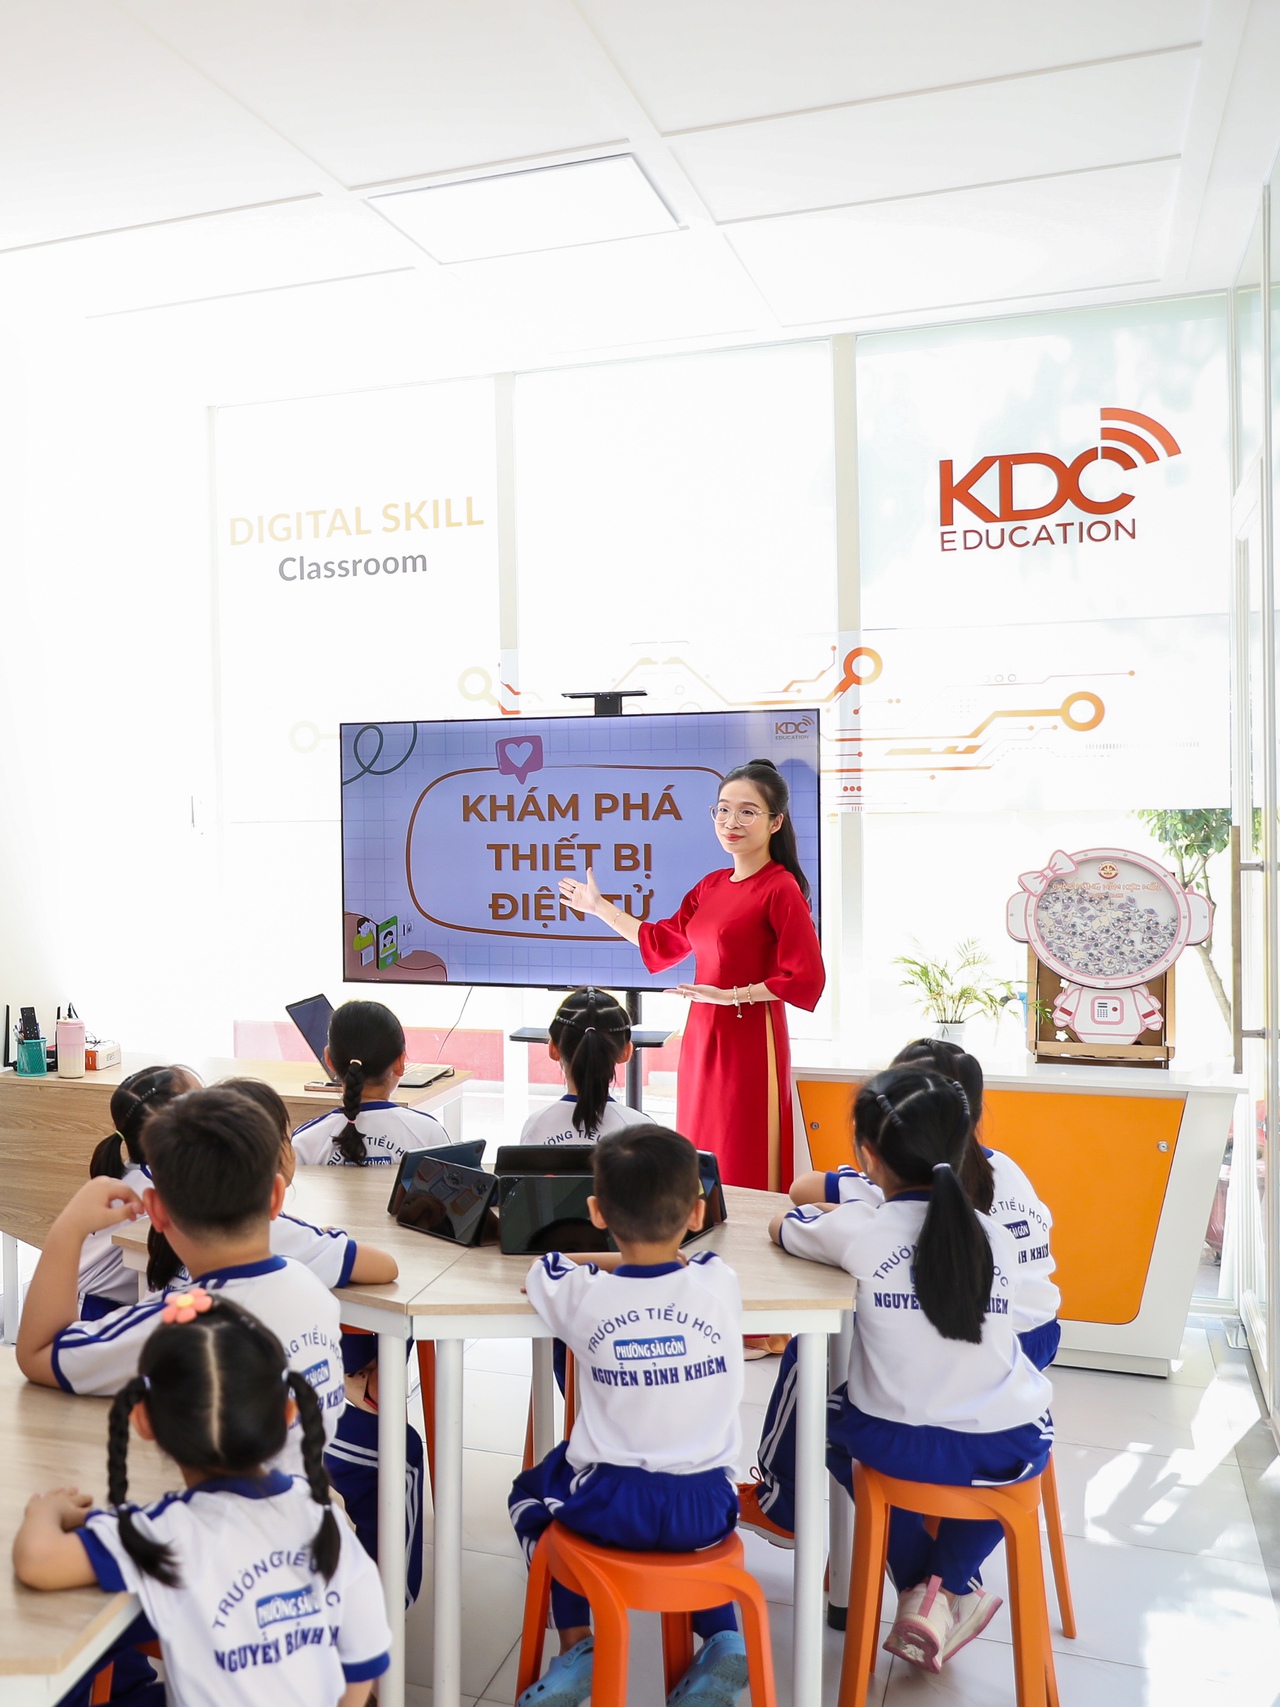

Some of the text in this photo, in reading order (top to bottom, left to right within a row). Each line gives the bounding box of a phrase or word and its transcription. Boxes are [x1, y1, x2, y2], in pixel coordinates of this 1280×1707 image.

[939, 447, 1137, 526] KDC
[229, 496, 484, 546] DIGITAL SKILL
[940, 518, 1136, 552] EDUCATION
[278, 554, 428, 581] Classroom
[775, 722, 808, 734] KDC
[461, 784, 682, 822] KHÁM PHÁ
[486, 833, 652, 880] THIẾT BỊ
[367, 1135, 394, 1150] TIỂU
[998, 1197, 1025, 1212] TIỂU
[873, 1244, 919, 1280] TRƯỜ
[301, 1325, 327, 1346] TIỂU
[588, 1303, 721, 1354] TRƯỜNG TIỂU HỌC
[615, 1338, 684, 1358] PHƯỜNG SÀI GÒN
[591, 1355, 727, 1386] NGUYỄN BỈNH KHIÊM
